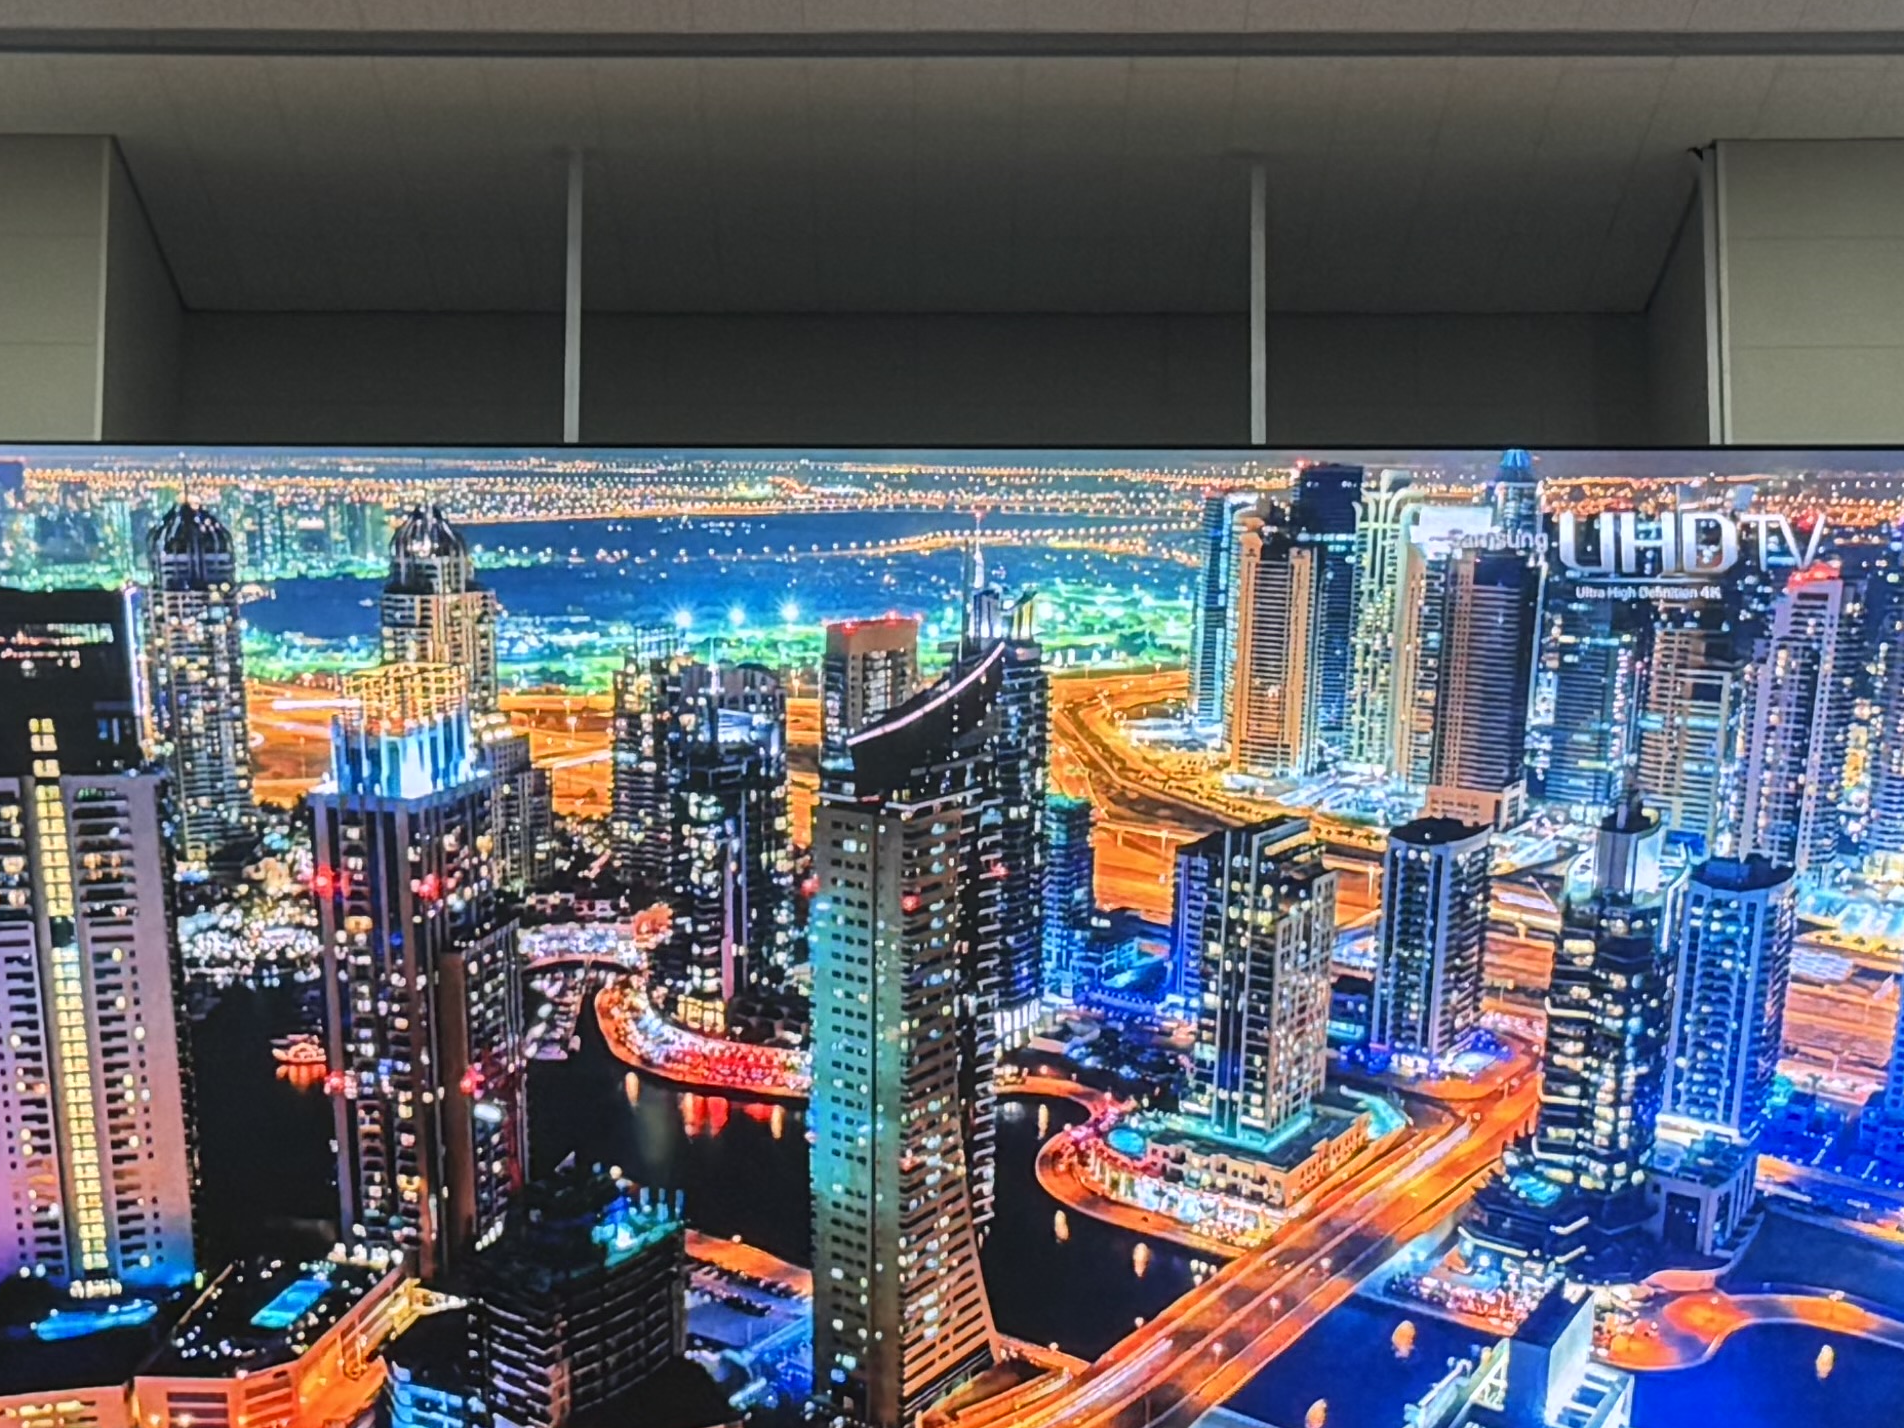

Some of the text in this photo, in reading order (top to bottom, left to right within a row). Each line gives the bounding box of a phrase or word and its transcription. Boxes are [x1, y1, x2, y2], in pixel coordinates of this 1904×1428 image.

[1576, 585, 1722, 601] Ultra High Definition 4K
